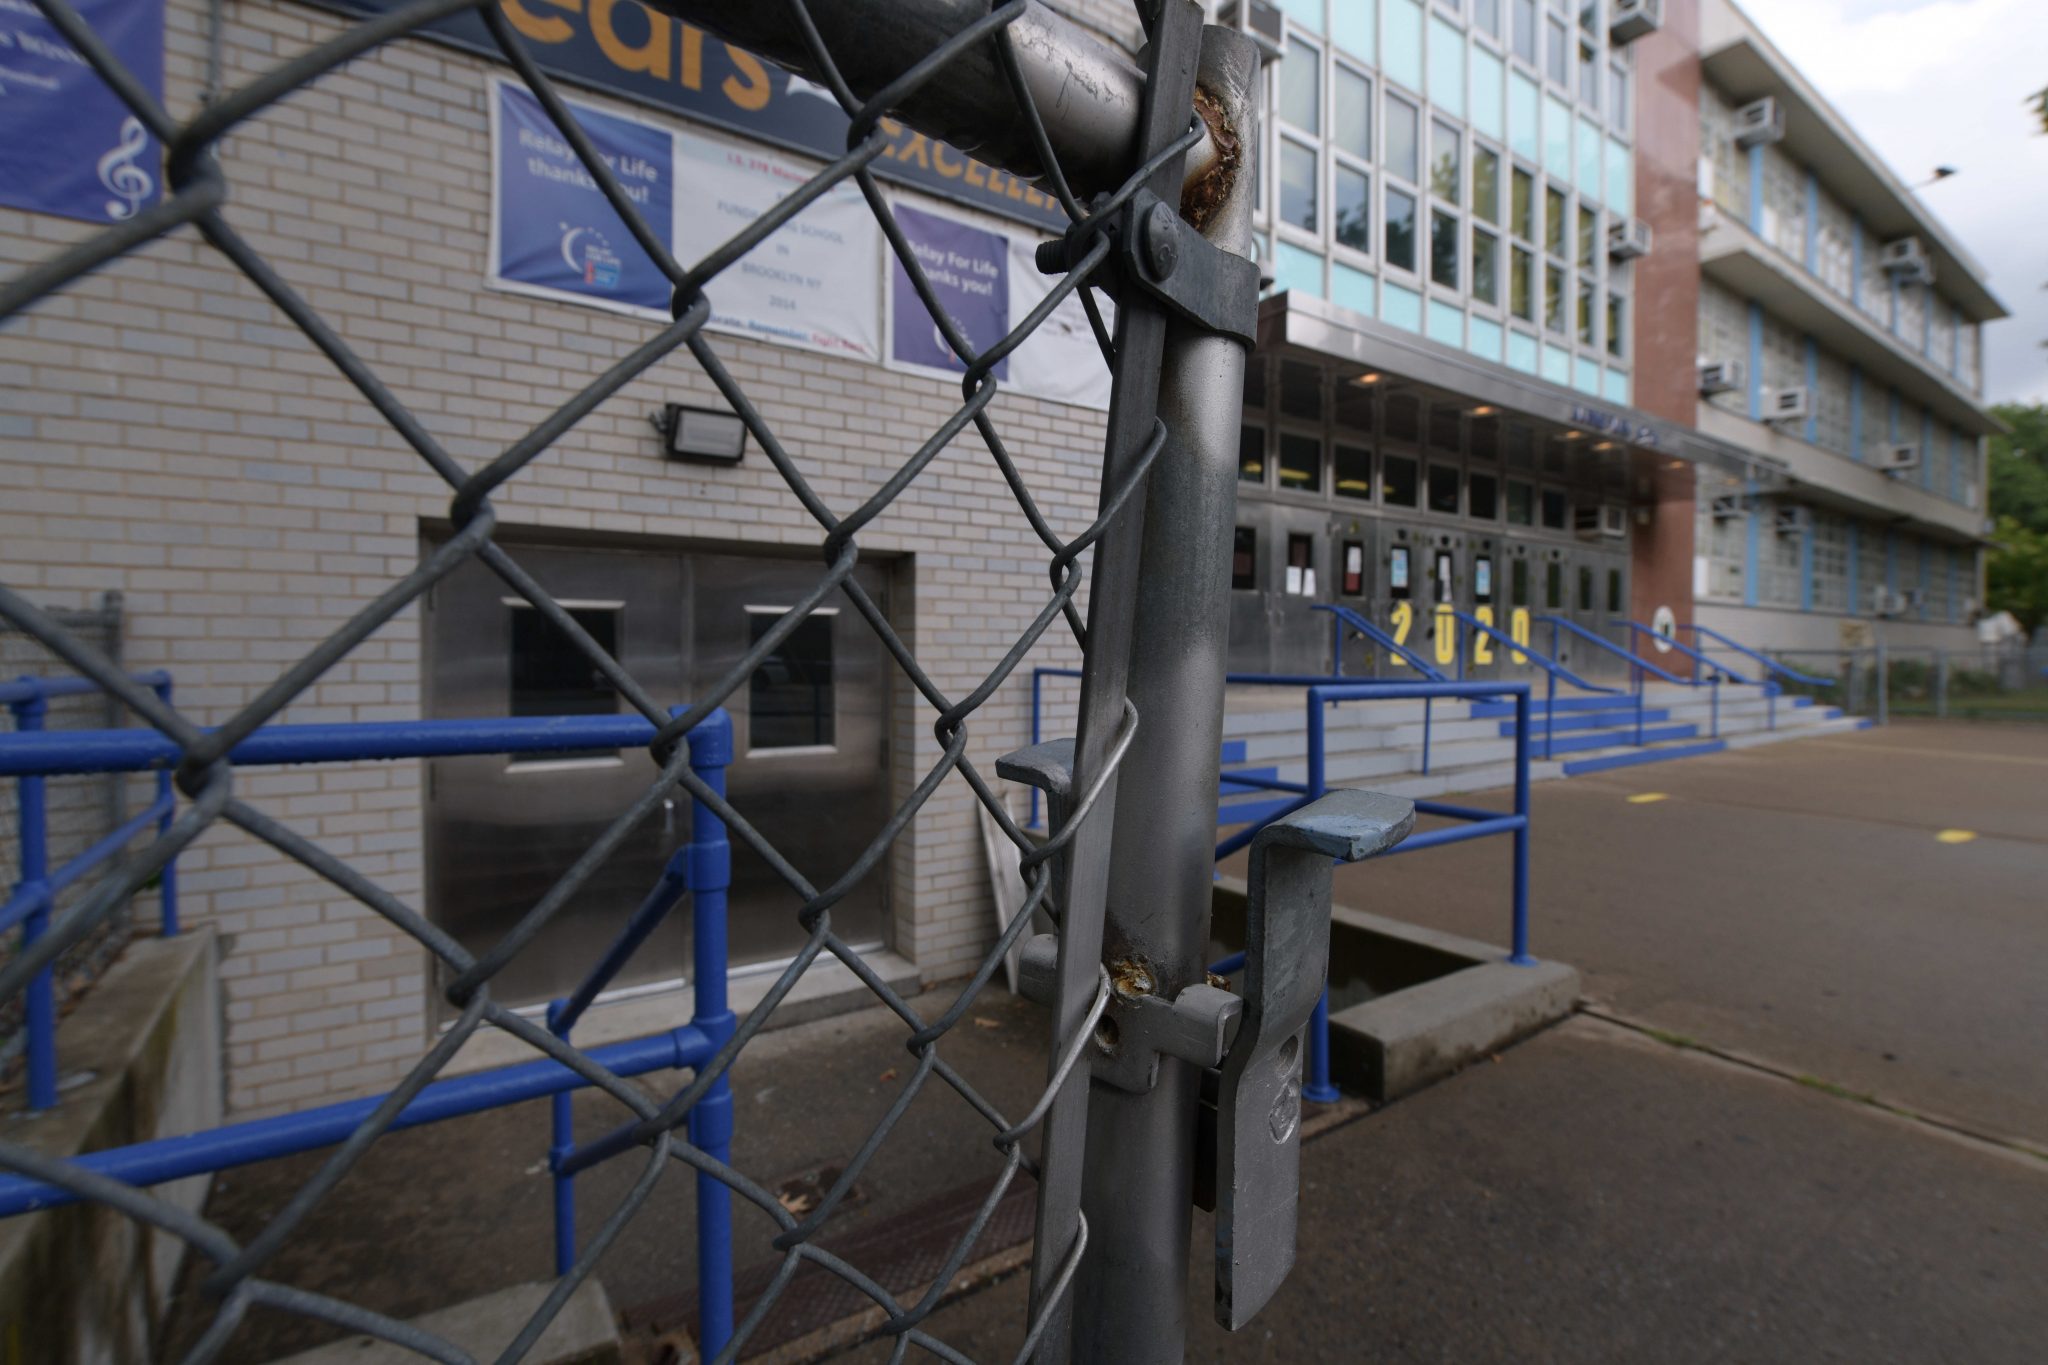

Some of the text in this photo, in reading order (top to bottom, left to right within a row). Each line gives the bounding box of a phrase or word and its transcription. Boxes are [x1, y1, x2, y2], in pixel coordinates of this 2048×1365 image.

[519, 128, 577, 164] Relay
[620, 155, 658, 183] Life
[948, 251, 971, 270] For
[973, 259, 999, 279] Life
[962, 277, 993, 296] you!
[1390, 600, 1530, 665] 2020
